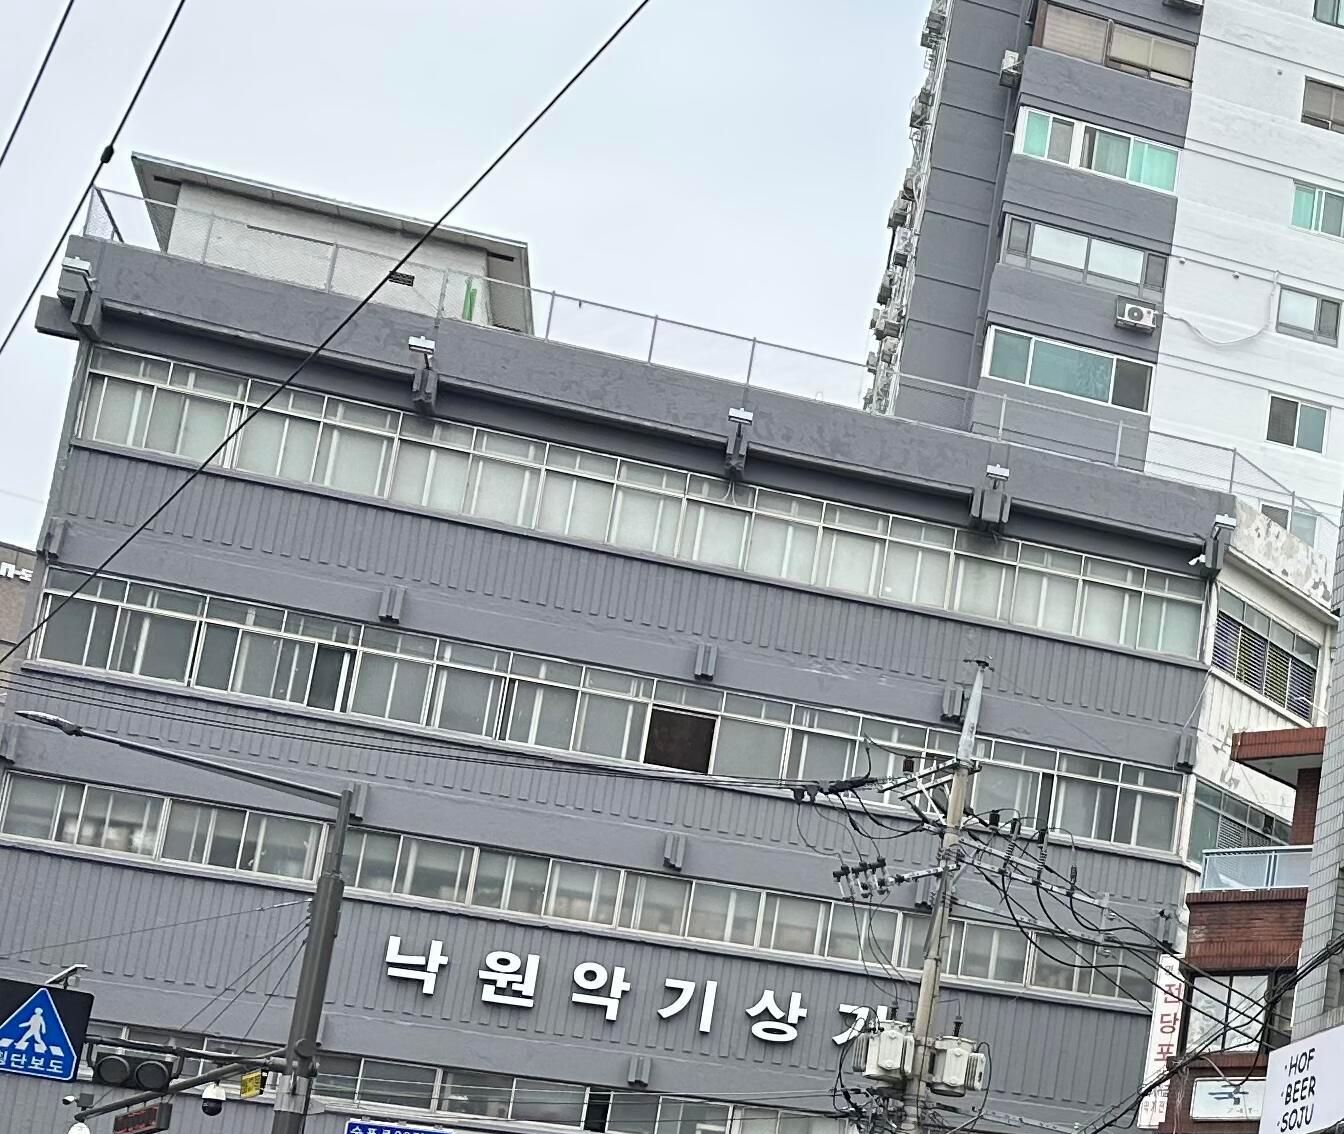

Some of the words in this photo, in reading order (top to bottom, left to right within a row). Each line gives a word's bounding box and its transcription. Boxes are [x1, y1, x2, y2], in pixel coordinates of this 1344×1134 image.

[1154, 982, 1183, 1062] 전당포
[1289, 1047, 1316, 1074] HOF
[1285, 1079, 1316, 1105] BEER
[1280, 1108, 1315, 1133] SOJU
